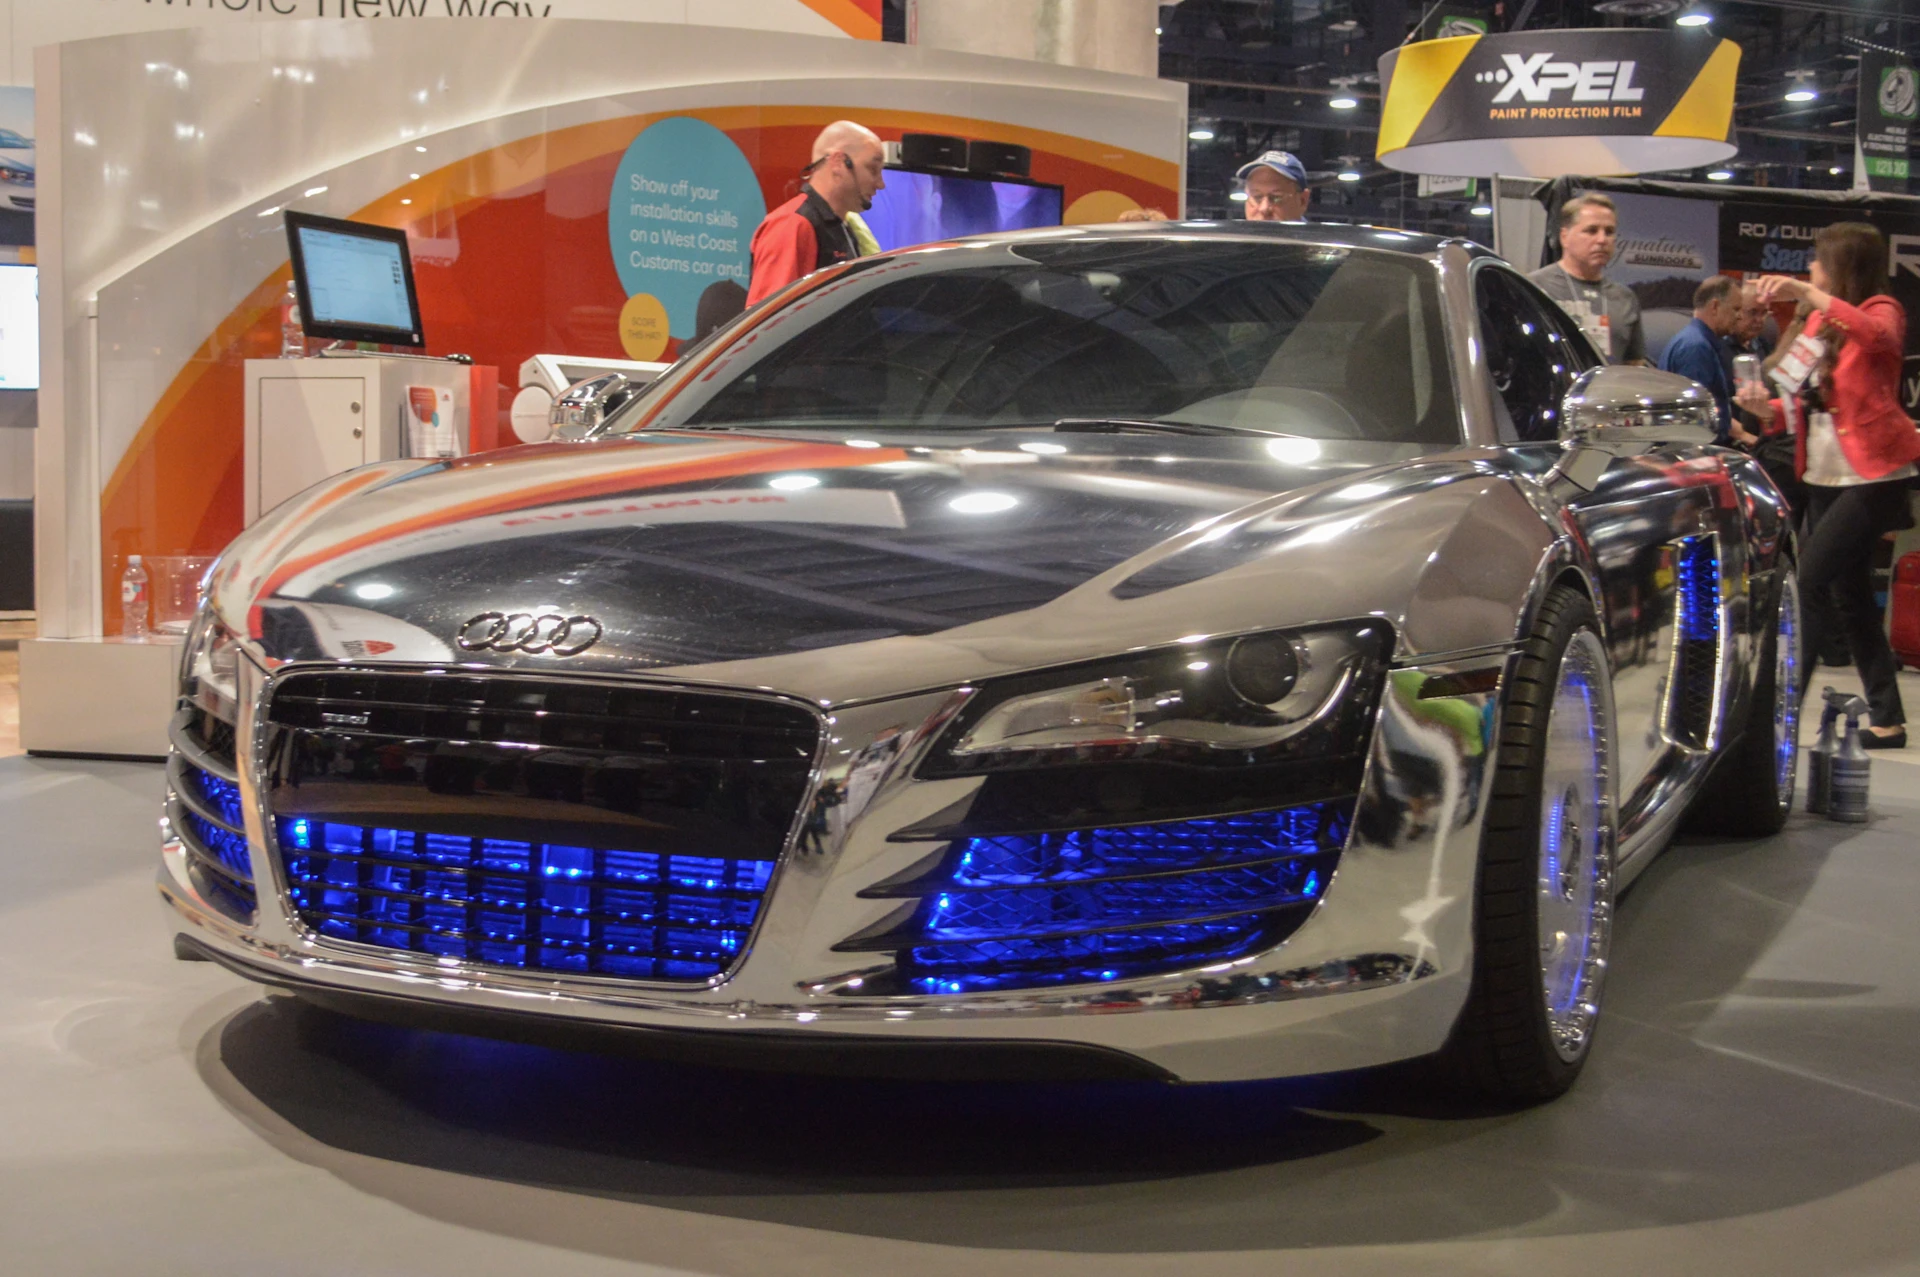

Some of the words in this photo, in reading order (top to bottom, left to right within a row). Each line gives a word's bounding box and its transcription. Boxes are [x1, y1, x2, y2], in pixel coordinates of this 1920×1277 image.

[1491, 53, 1645, 103] XPEL
[1489, 107, 1528, 119] PAINT
[1530, 106, 1610, 119] PROTECTION
[1612, 106, 1642, 118] FILM
[630, 173, 669, 195] Show
[670, 179, 690, 197] off
[690, 184, 720, 203] your
[630, 197, 704, 224] installation
[705, 209, 739, 229] skills
[629, 229, 648, 243] on
[650, 231, 660, 245] a
[661, 228, 696, 249] West
[697, 232, 738, 253] Coast
[629, 250, 690, 274] Customs
[692, 260, 715, 275] car
[1633, 252, 1695, 267] SUNROOFS
